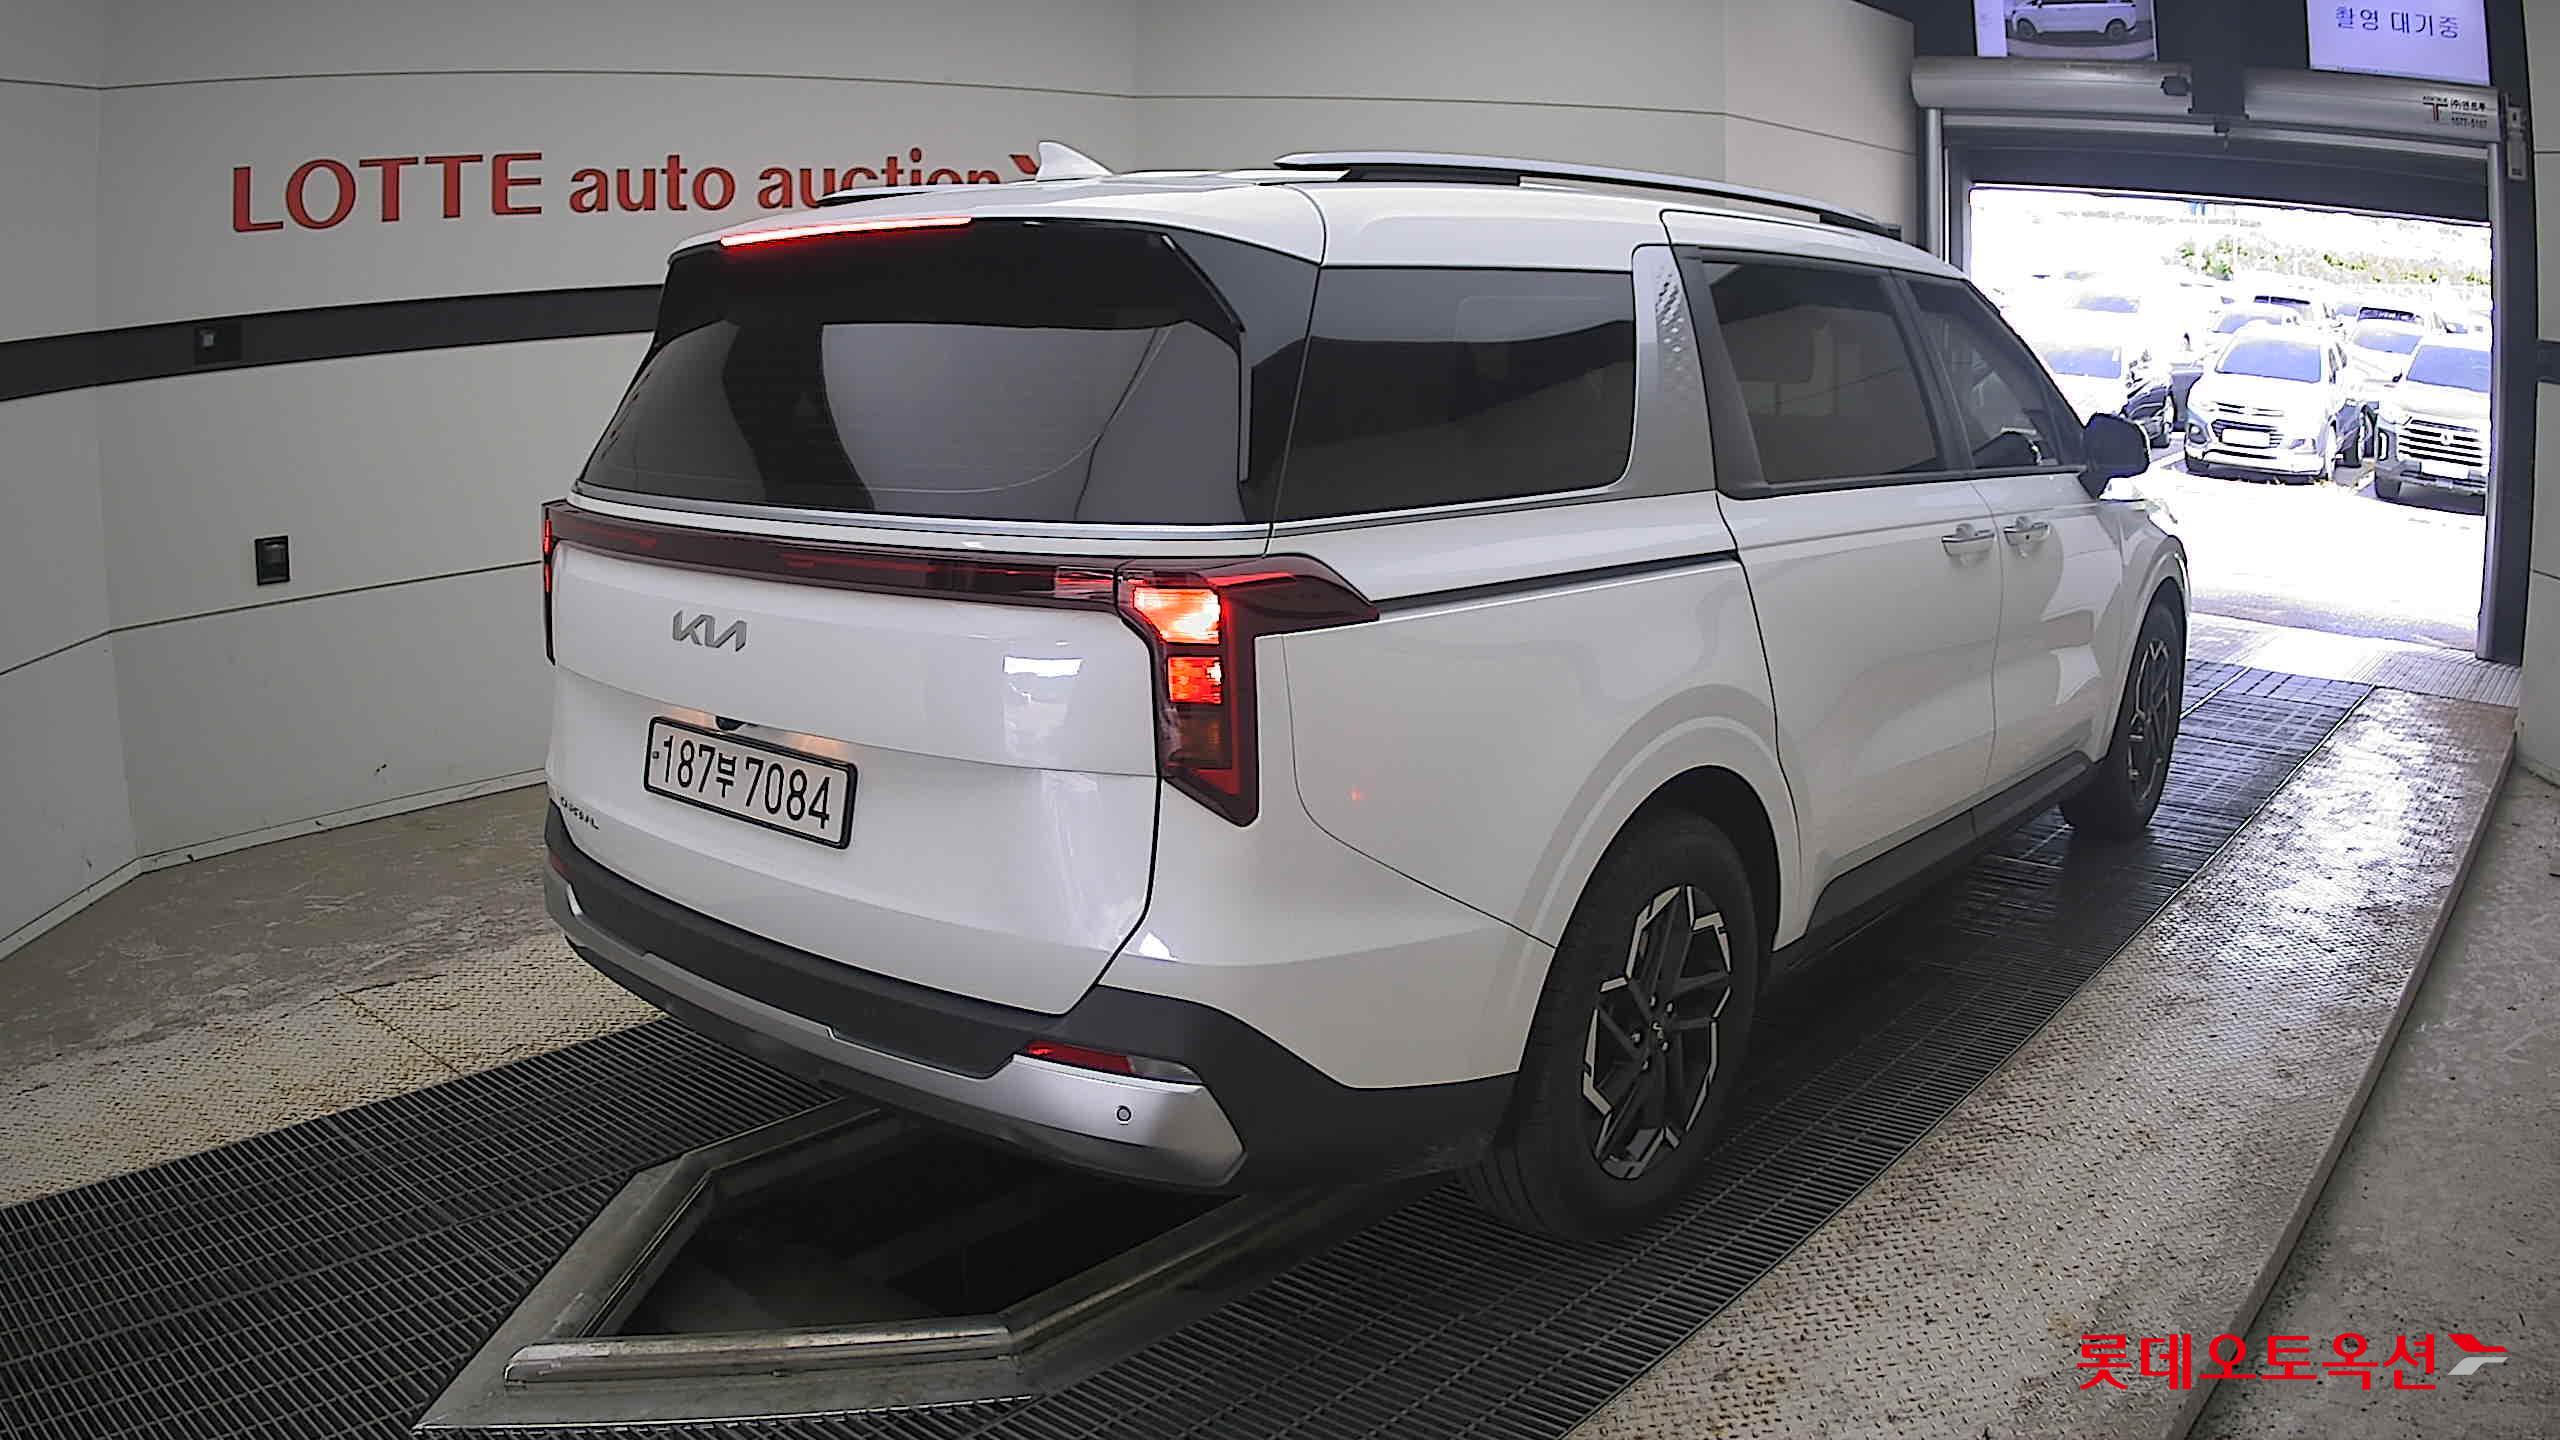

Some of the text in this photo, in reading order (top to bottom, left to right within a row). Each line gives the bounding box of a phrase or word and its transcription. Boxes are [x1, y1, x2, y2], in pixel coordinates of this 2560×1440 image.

[2391, 11, 2458, 39] 대기중
[232, 152, 543, 233] LOTTE
[568, 153, 736, 213] auto
[744, 755, 832, 830] 7084
